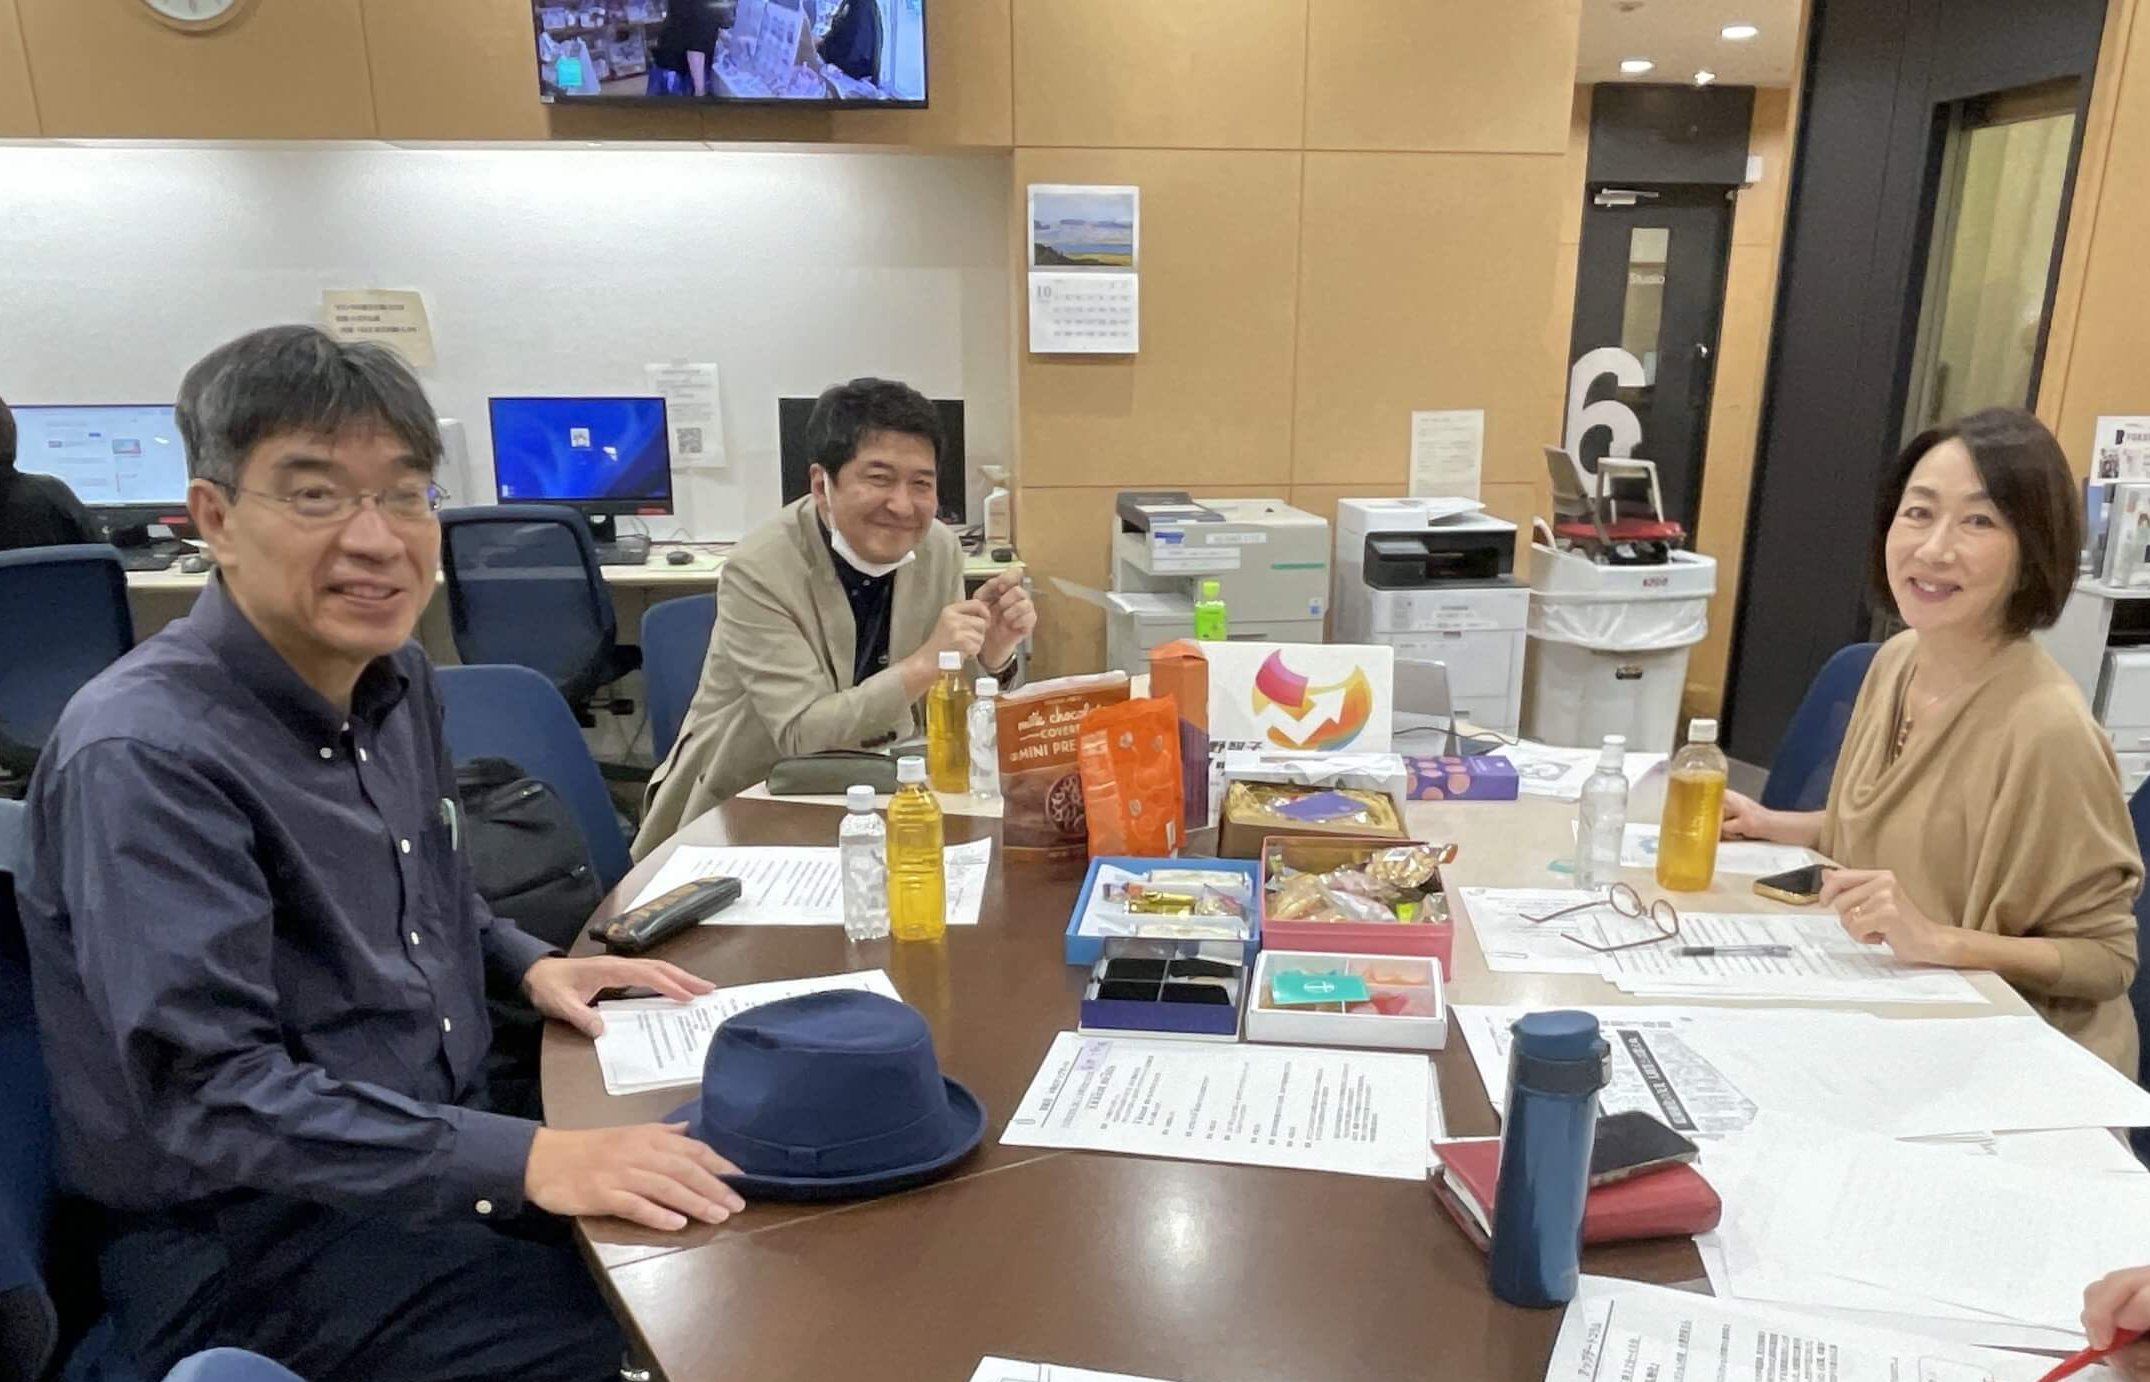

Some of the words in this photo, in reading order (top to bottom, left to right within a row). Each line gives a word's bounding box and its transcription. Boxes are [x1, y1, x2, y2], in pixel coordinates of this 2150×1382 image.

[1037, 285, 1052, 297] 10
[1566, 347, 1645, 498] 6
[1018, 743, 1049, 761] MINI
[1052, 739, 1077, 755] PRE
